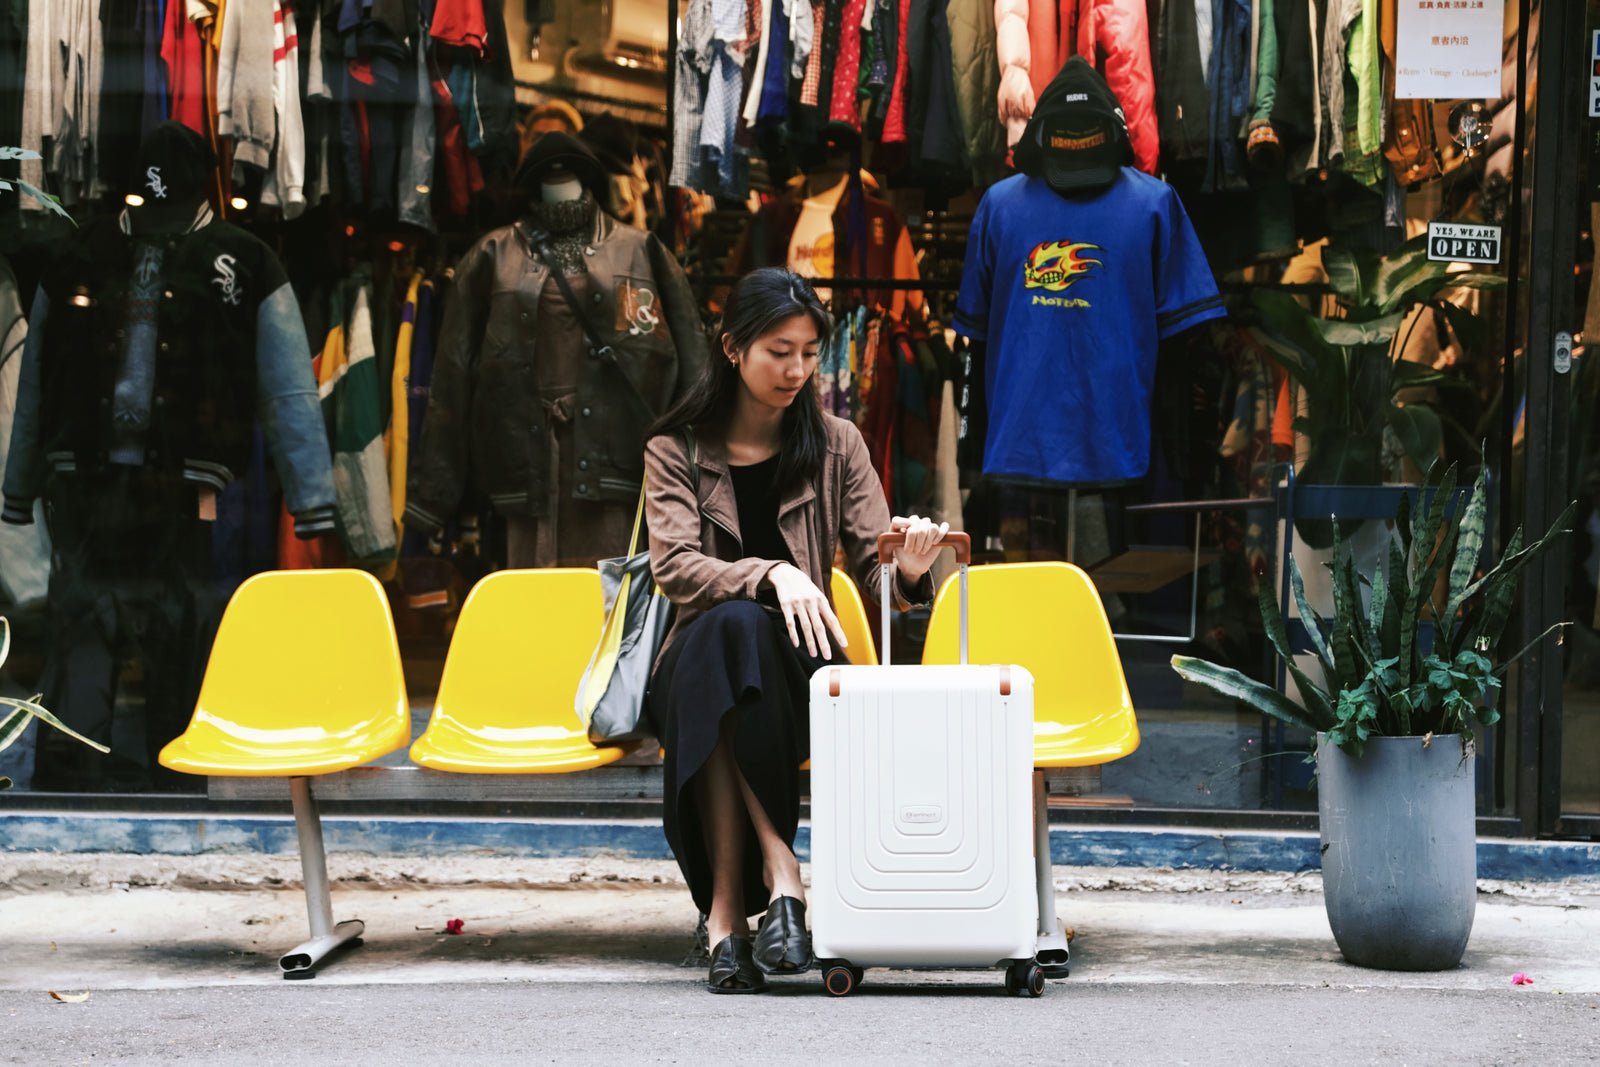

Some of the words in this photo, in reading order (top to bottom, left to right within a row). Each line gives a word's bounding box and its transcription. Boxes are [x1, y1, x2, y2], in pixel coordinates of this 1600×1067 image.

[1435, 226, 1457, 237] YES,
[1460, 228, 1474, 237] WE
[1476, 229, 1496, 239] ARE
[1436, 239, 1492, 258] OPEN
